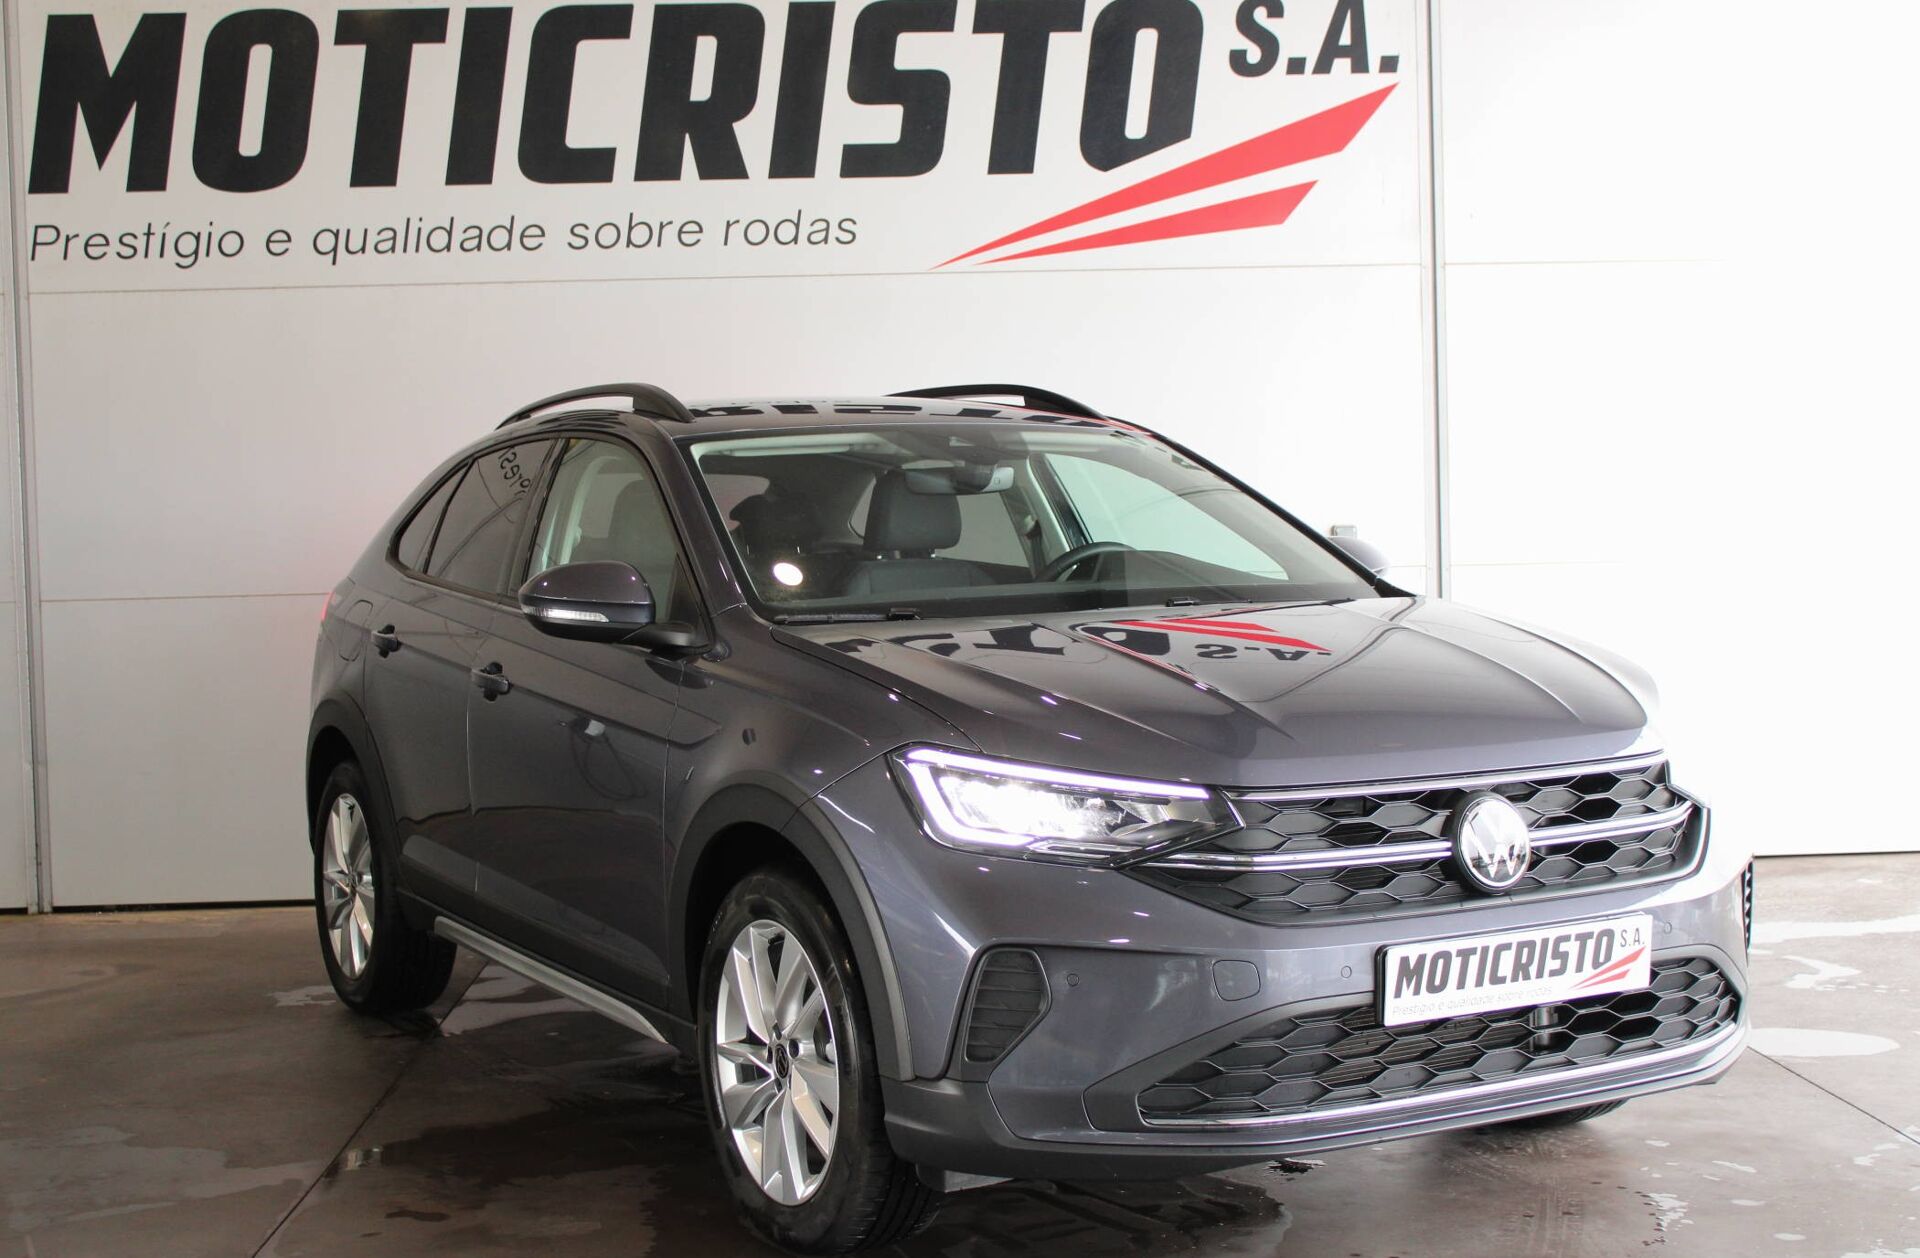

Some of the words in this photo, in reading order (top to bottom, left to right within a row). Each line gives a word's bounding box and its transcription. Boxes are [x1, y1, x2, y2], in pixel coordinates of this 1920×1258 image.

[28, 0, 1203, 194] MOTICRISTO
[1230, 0, 1400, 78] S.A.
[30, 221, 245, 270] Prestígio
[266, 229, 292, 257] e
[312, 216, 546, 266] qualidade
[567, 213, 704, 250] sobre
[723, 209, 857, 247] rodas
[1393, 928, 1615, 999] MOTICRISTO
[1620, 927, 1646, 948] S.A.
